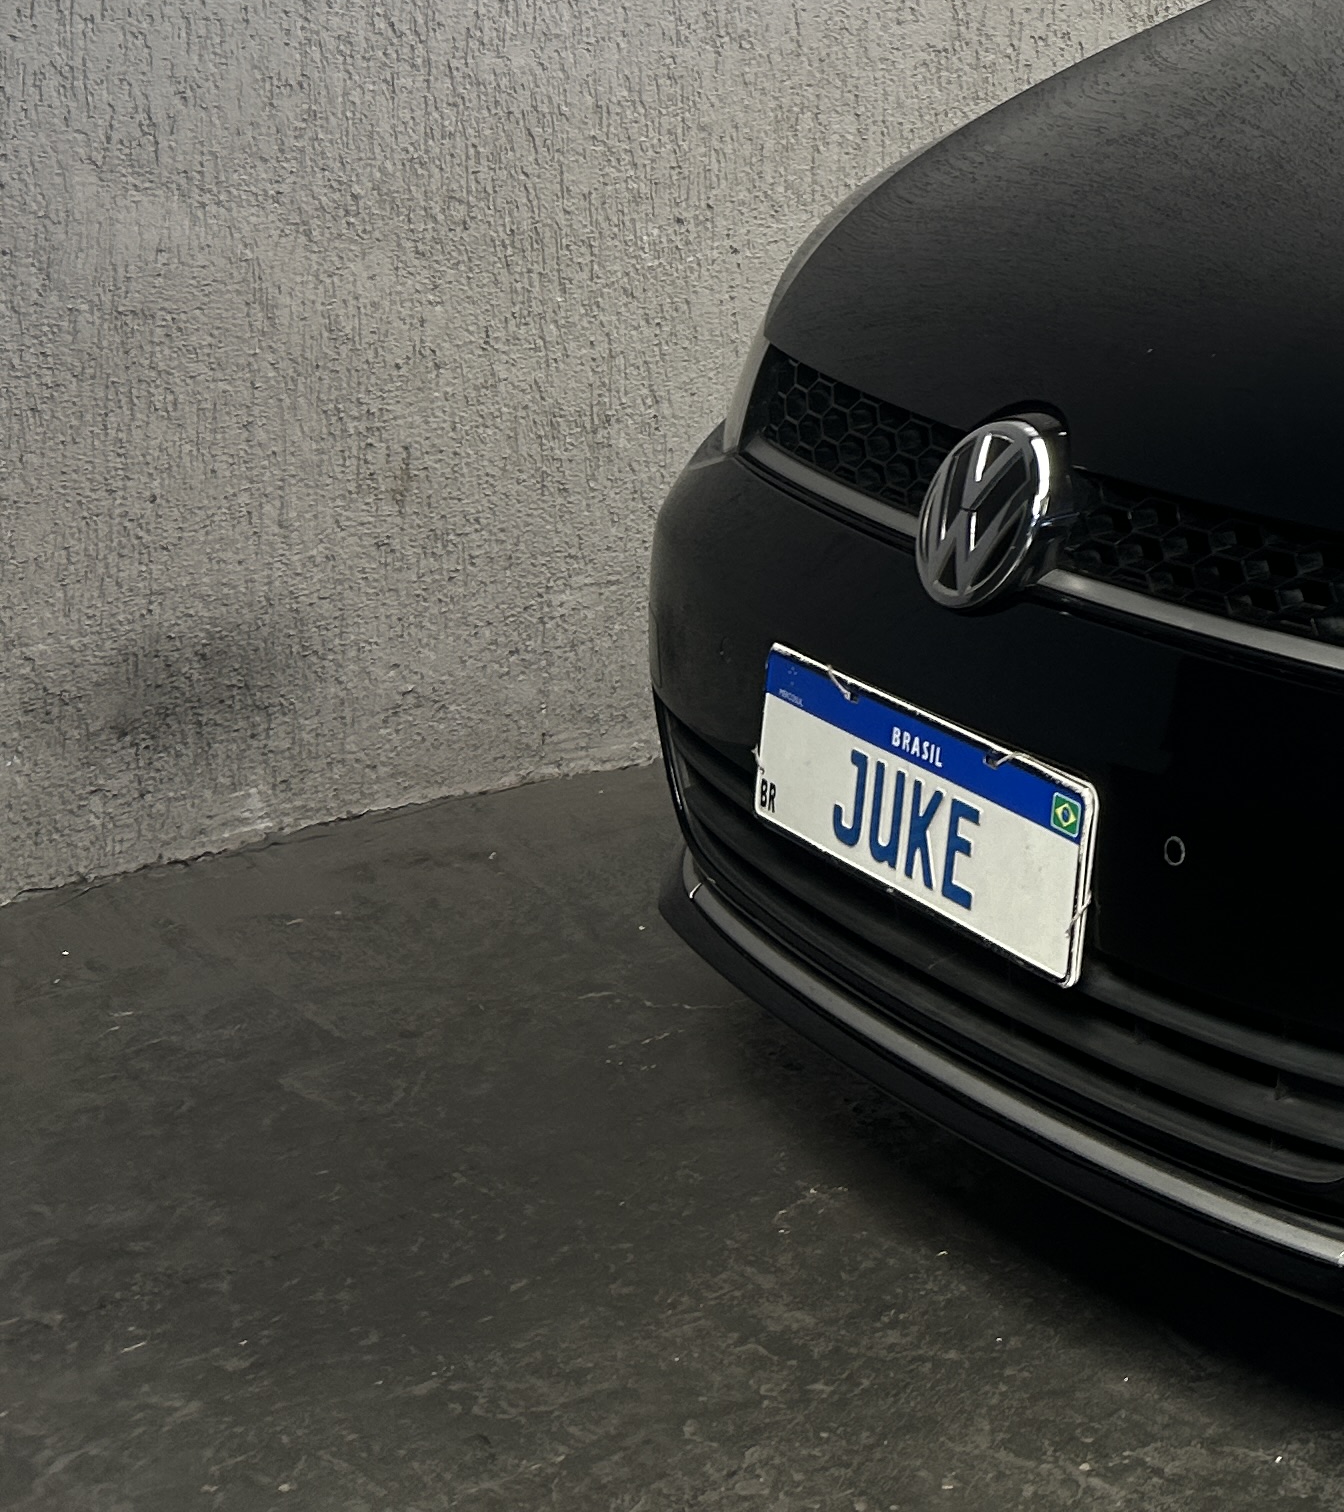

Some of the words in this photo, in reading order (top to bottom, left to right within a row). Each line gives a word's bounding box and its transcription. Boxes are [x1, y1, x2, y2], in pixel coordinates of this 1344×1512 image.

[891, 726, 944, 769] BRASIL
[759, 778, 777, 814] BR
[832, 747, 982, 912] JUKE
